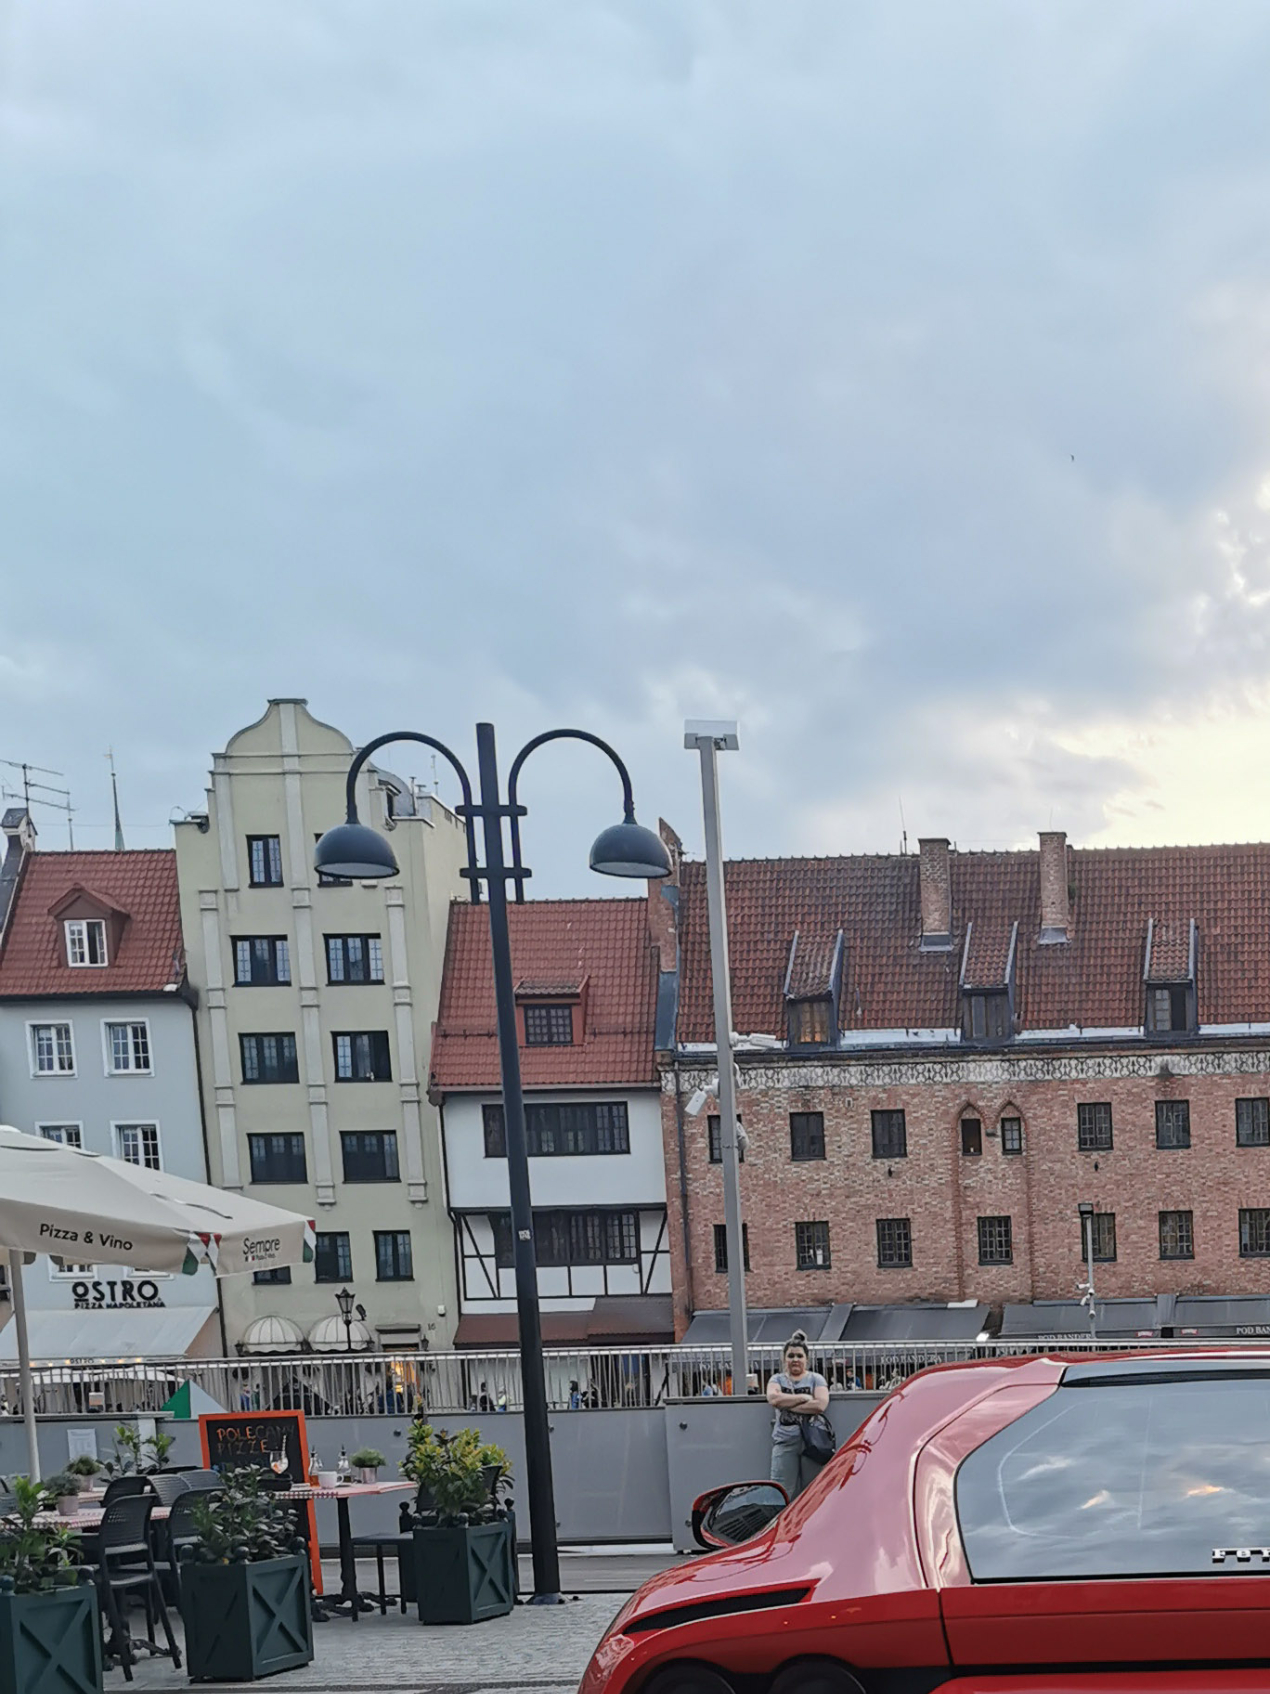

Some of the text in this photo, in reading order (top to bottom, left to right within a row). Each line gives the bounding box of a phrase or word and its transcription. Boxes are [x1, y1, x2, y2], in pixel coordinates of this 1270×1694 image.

[39, 1223, 133, 1251] Pizza & Vino
[242, 1237, 280, 1255] Sempre
[72, 1280, 159, 1303] OSTRO
[1236, 1326, 1254, 1335] POD
